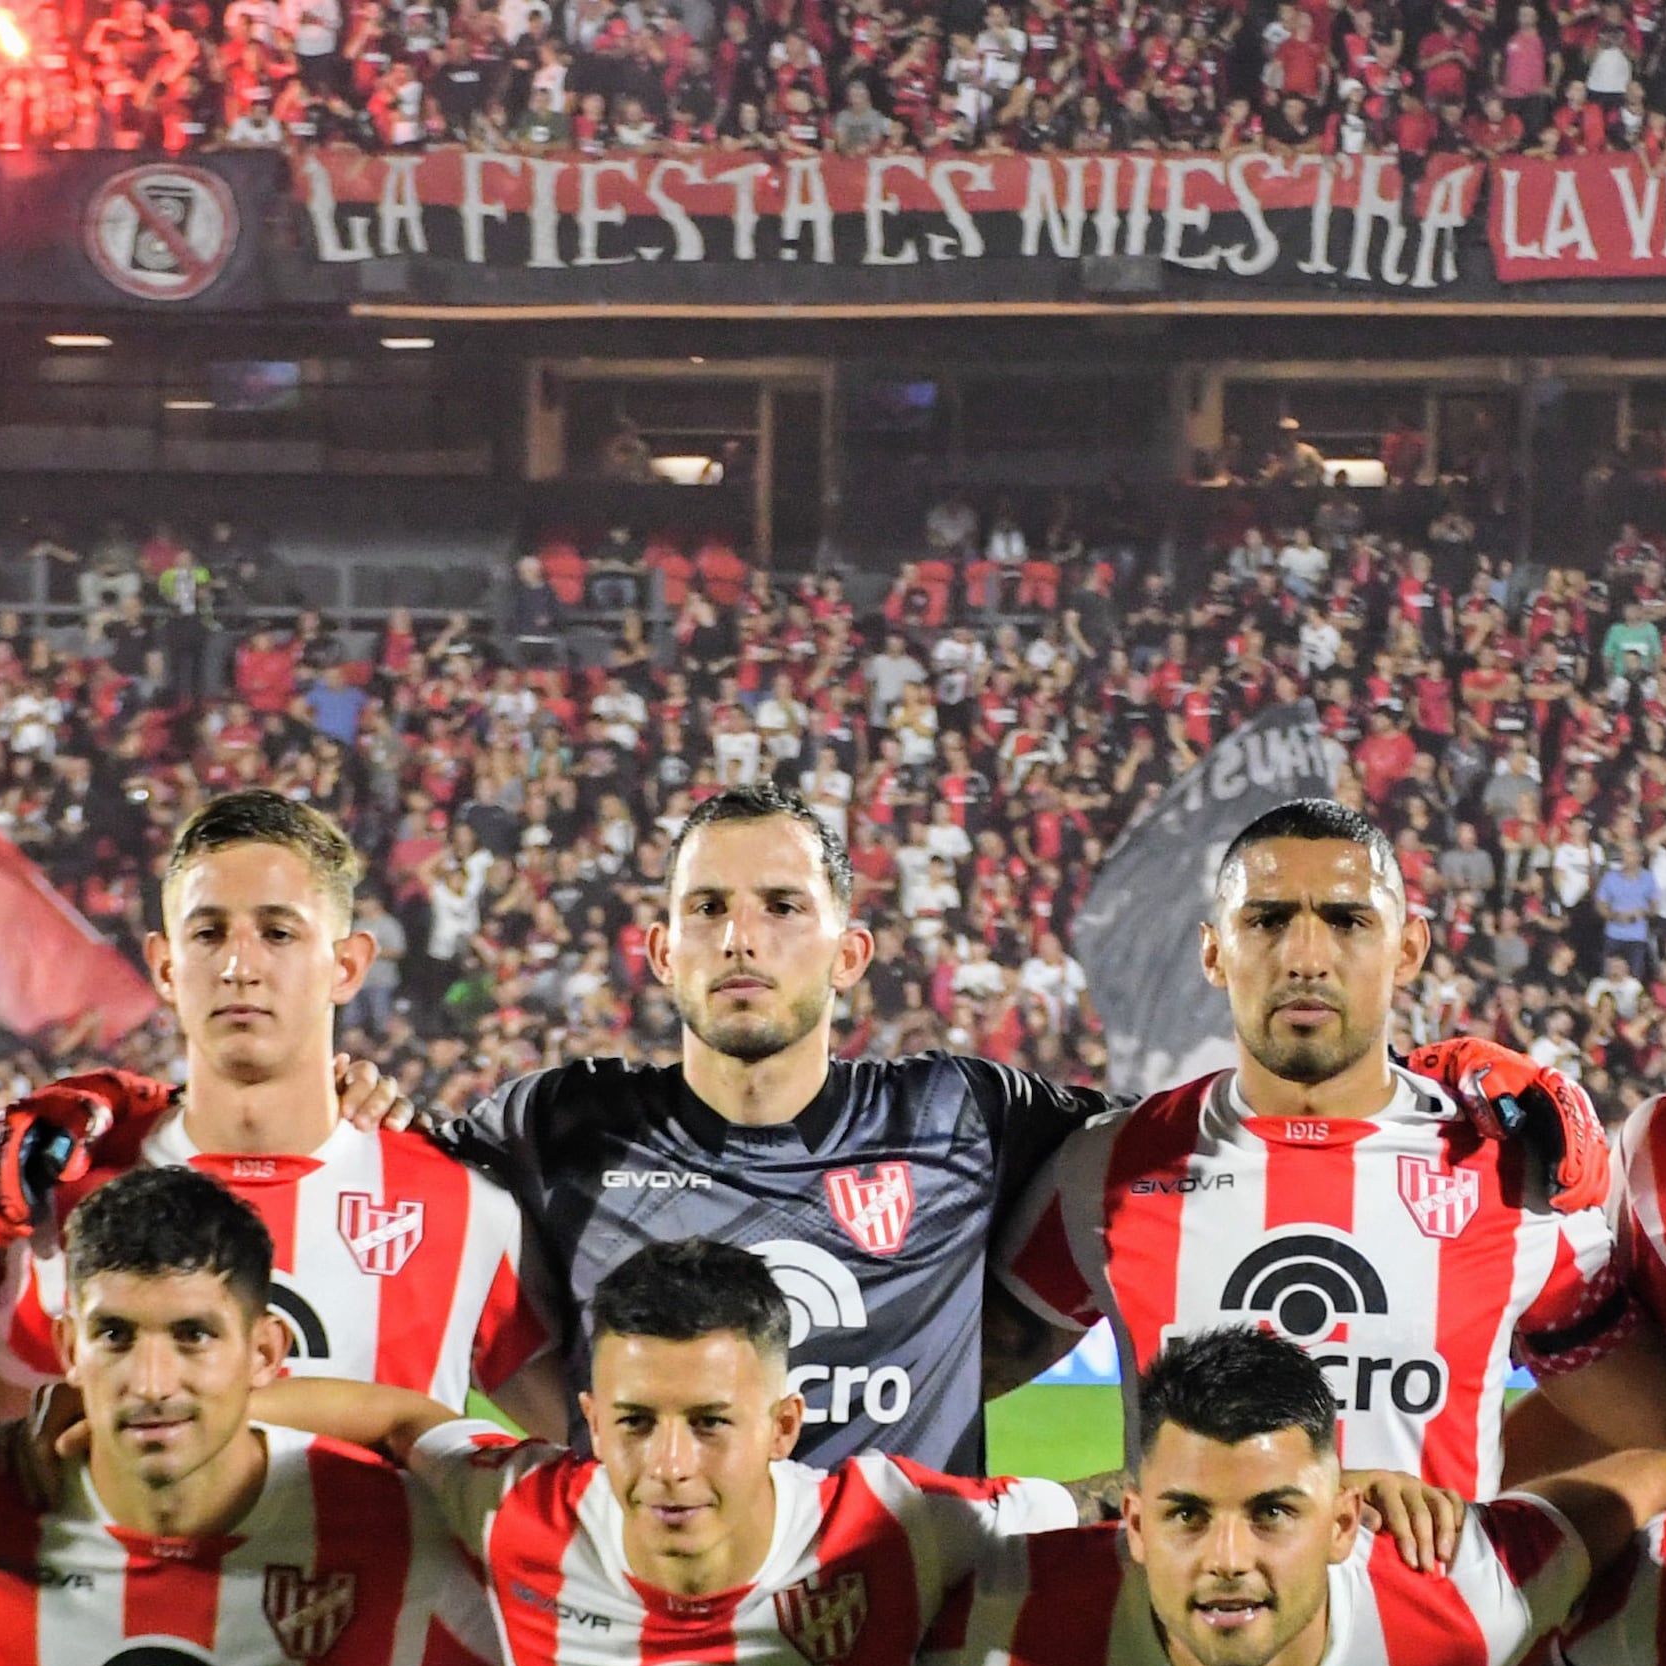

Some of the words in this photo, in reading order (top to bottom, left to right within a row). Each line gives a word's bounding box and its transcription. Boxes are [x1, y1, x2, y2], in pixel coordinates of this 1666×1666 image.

[304, 154, 427, 264] LA
[461, 150, 837, 268] FIESTA
[864, 153, 993, 267] ES
[1019, 152, 1475, 290] NUESTRA
[1499, 168, 1599, 260] LA
[1283, 1120, 1330, 1141] 1918
[601, 1169, 712, 1191] GIVOVA
[1131, 1172, 1235, 1195] GIVOVA
[788, 1363, 911, 1426] cro
[1315, 1354, 1442, 1416] cro
